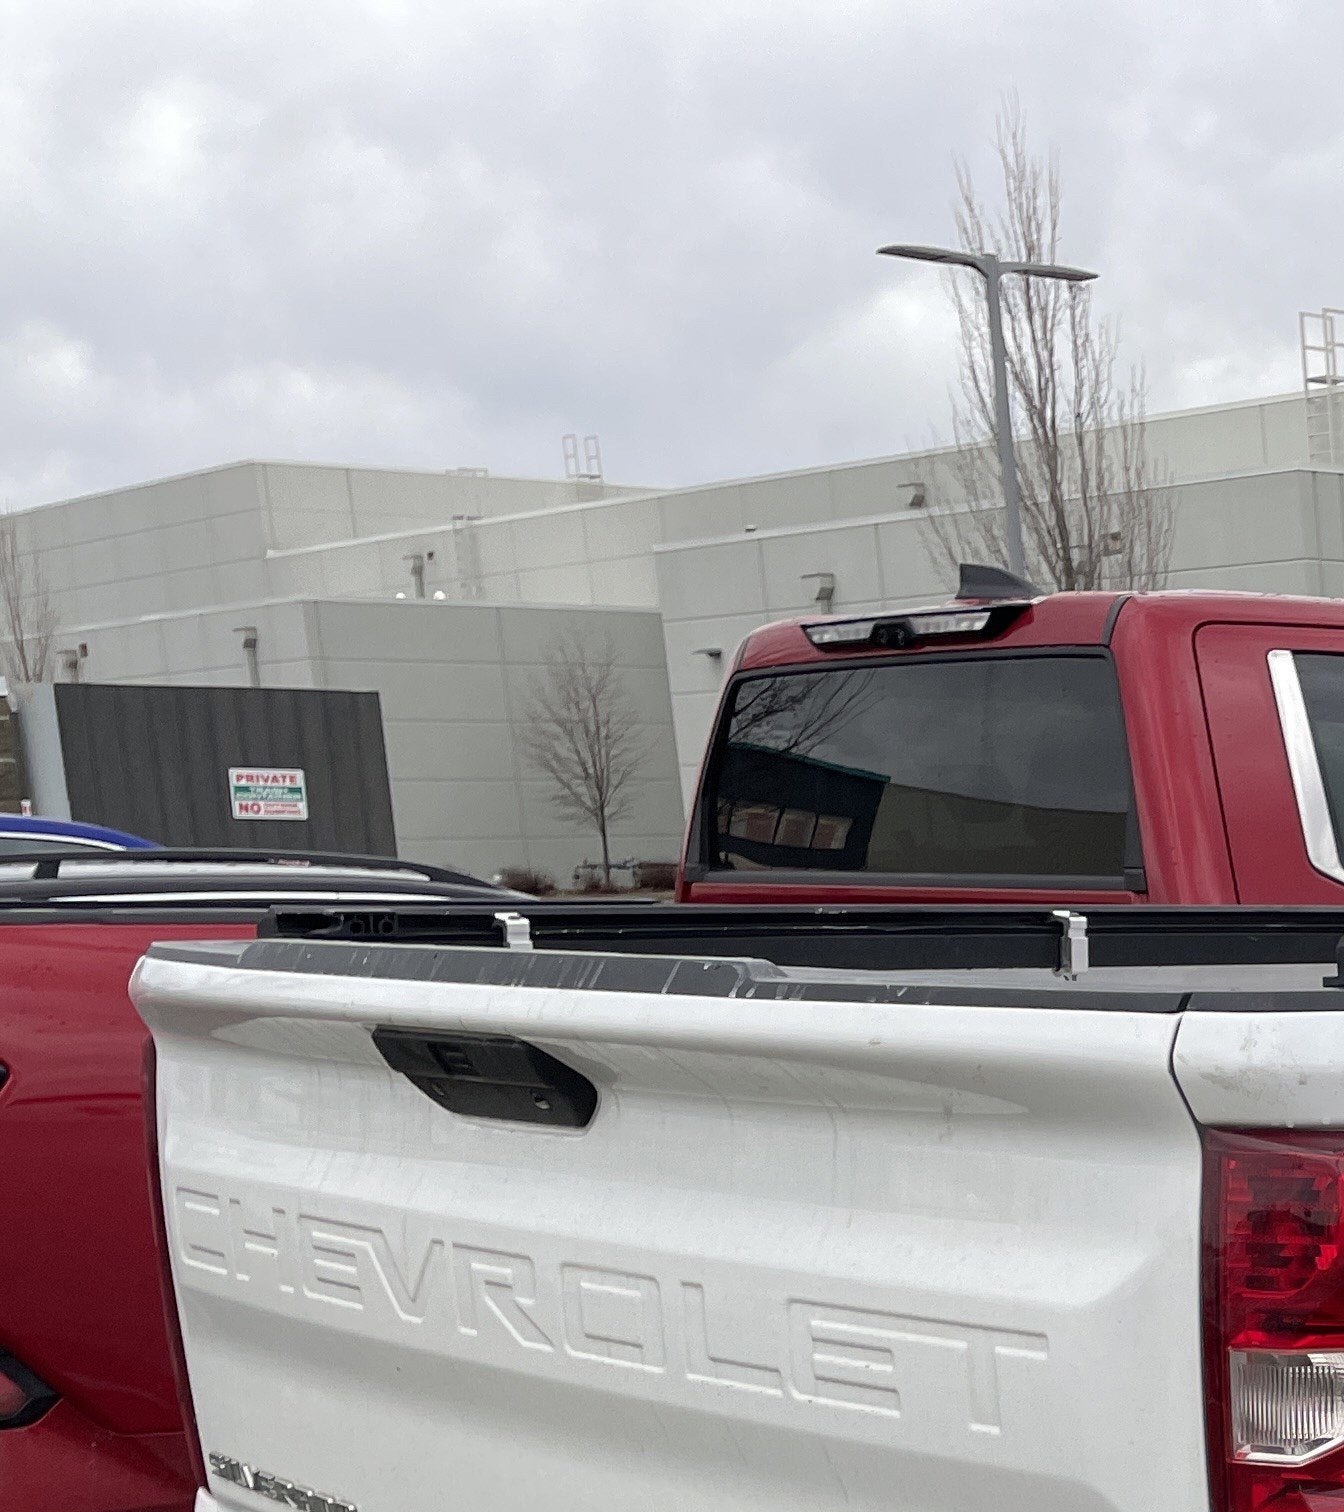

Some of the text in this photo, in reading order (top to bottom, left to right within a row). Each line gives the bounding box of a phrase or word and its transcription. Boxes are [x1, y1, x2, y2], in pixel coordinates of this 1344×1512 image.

[236, 773, 297, 785] PRIVATE
[239, 802, 262, 815] NO
[174, 1186, 1050, 1436] CHEVROLET
